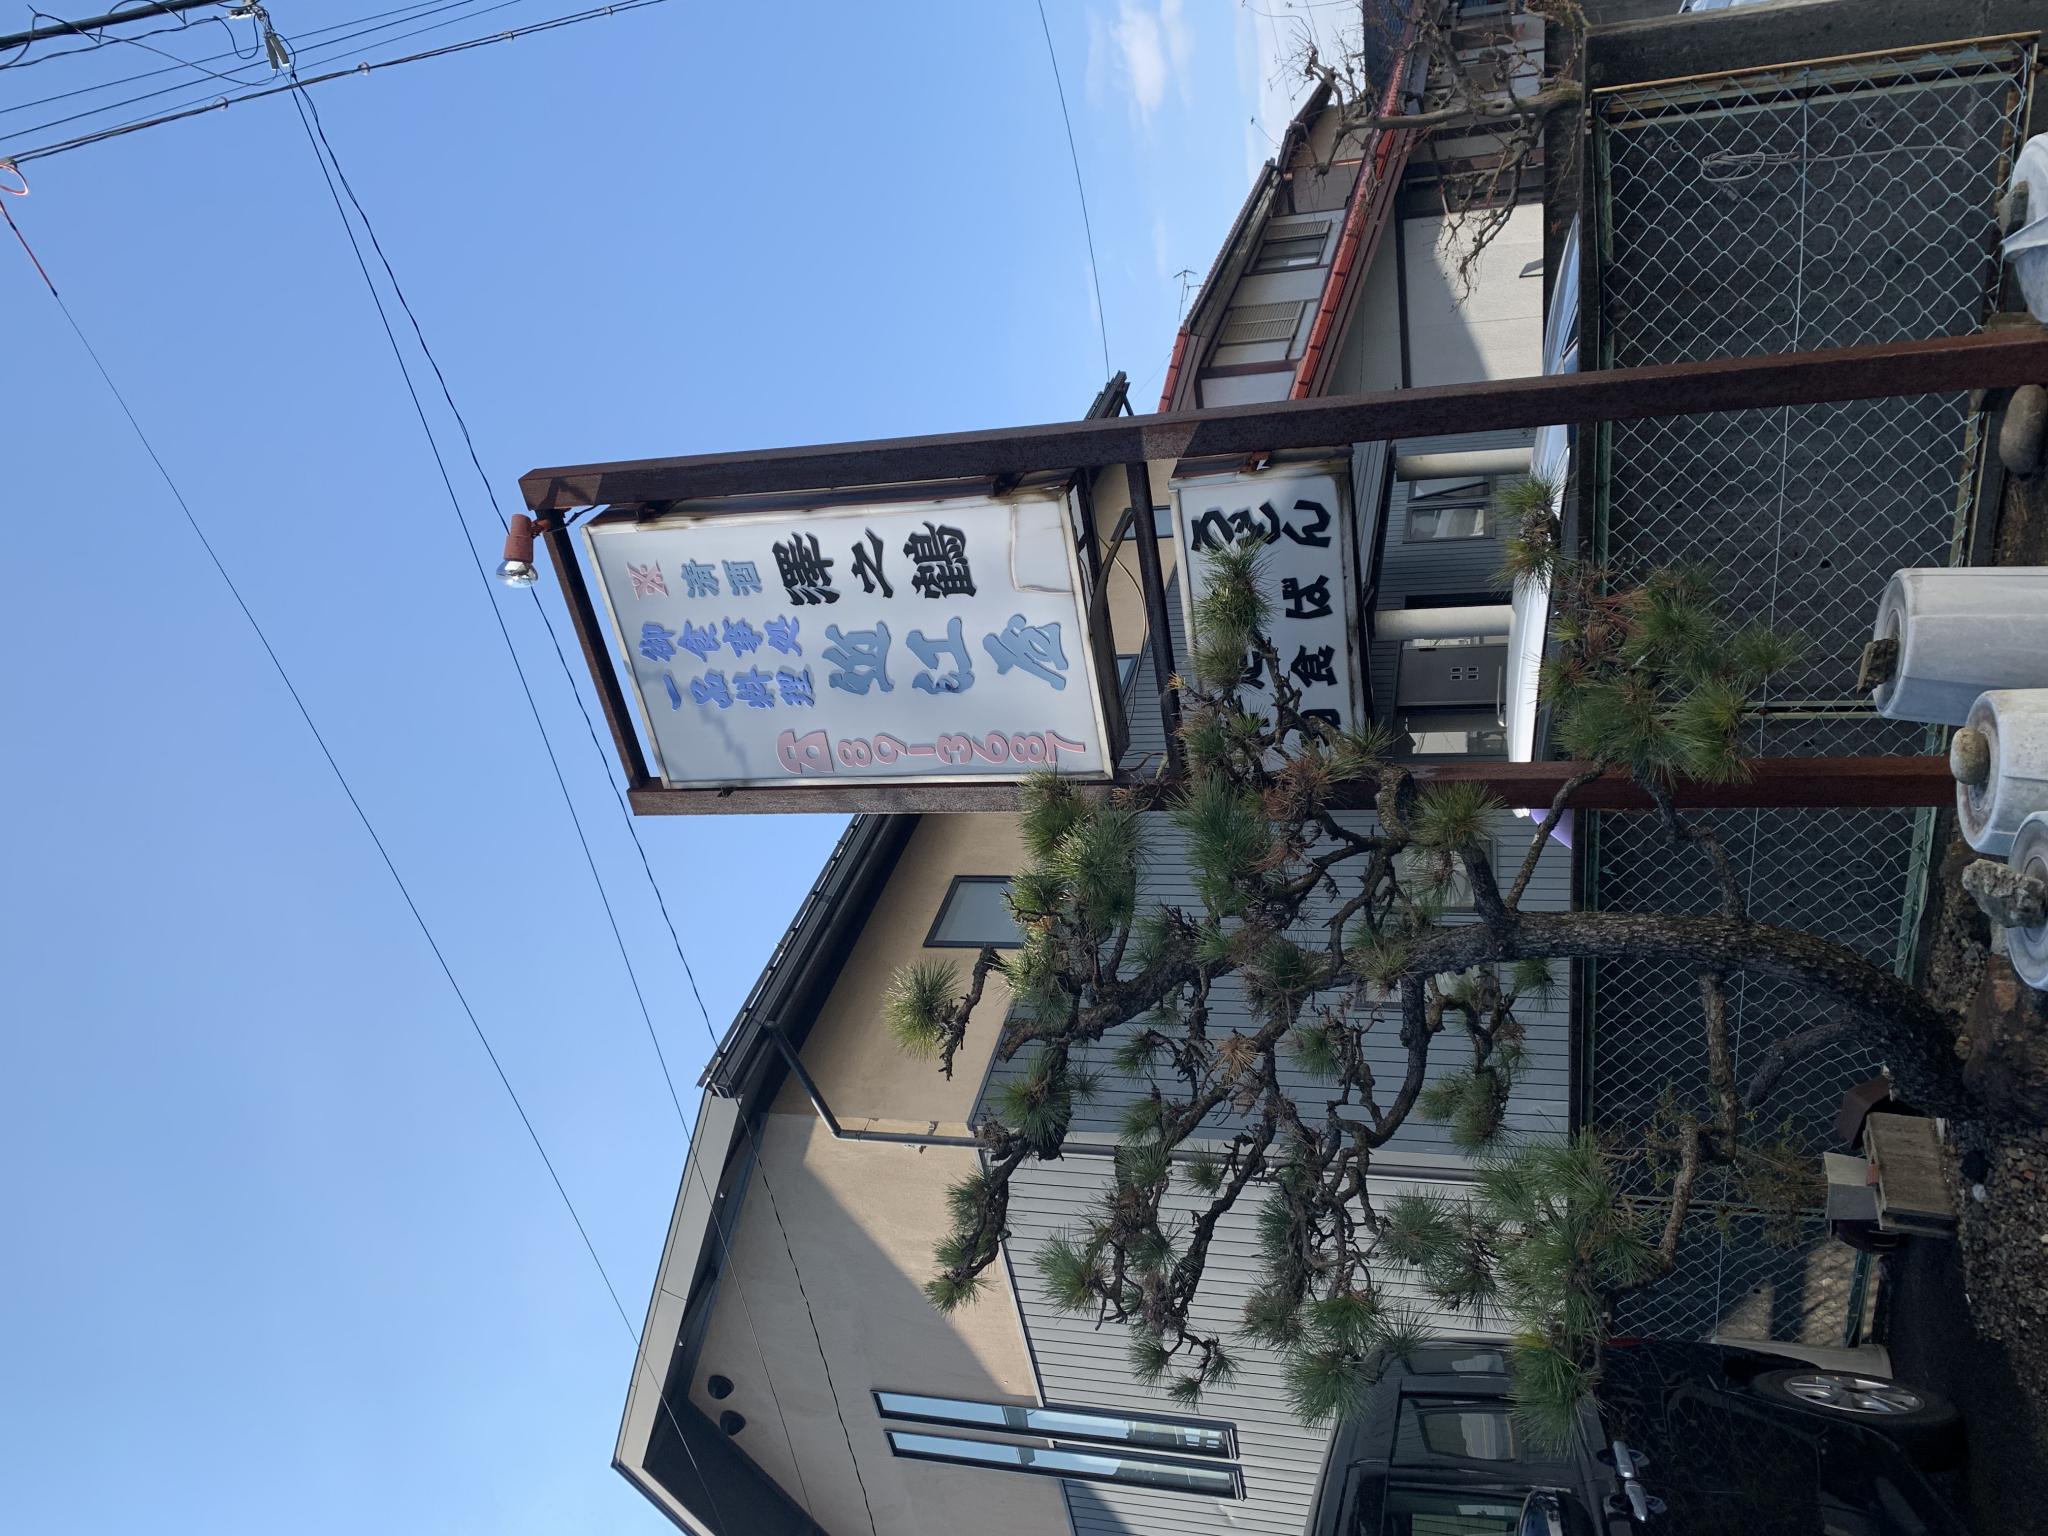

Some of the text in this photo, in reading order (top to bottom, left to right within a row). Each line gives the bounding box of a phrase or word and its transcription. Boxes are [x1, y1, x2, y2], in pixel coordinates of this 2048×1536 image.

[1191, 499, 1332, 552] うどん
[681, 521, 977, 606] 清酒 澤之鶴
[638, 614, 804, 663] 御食事処
[821, 613, 1069, 696] 近江屋
[661, 664, 817, 711] 一品料理
